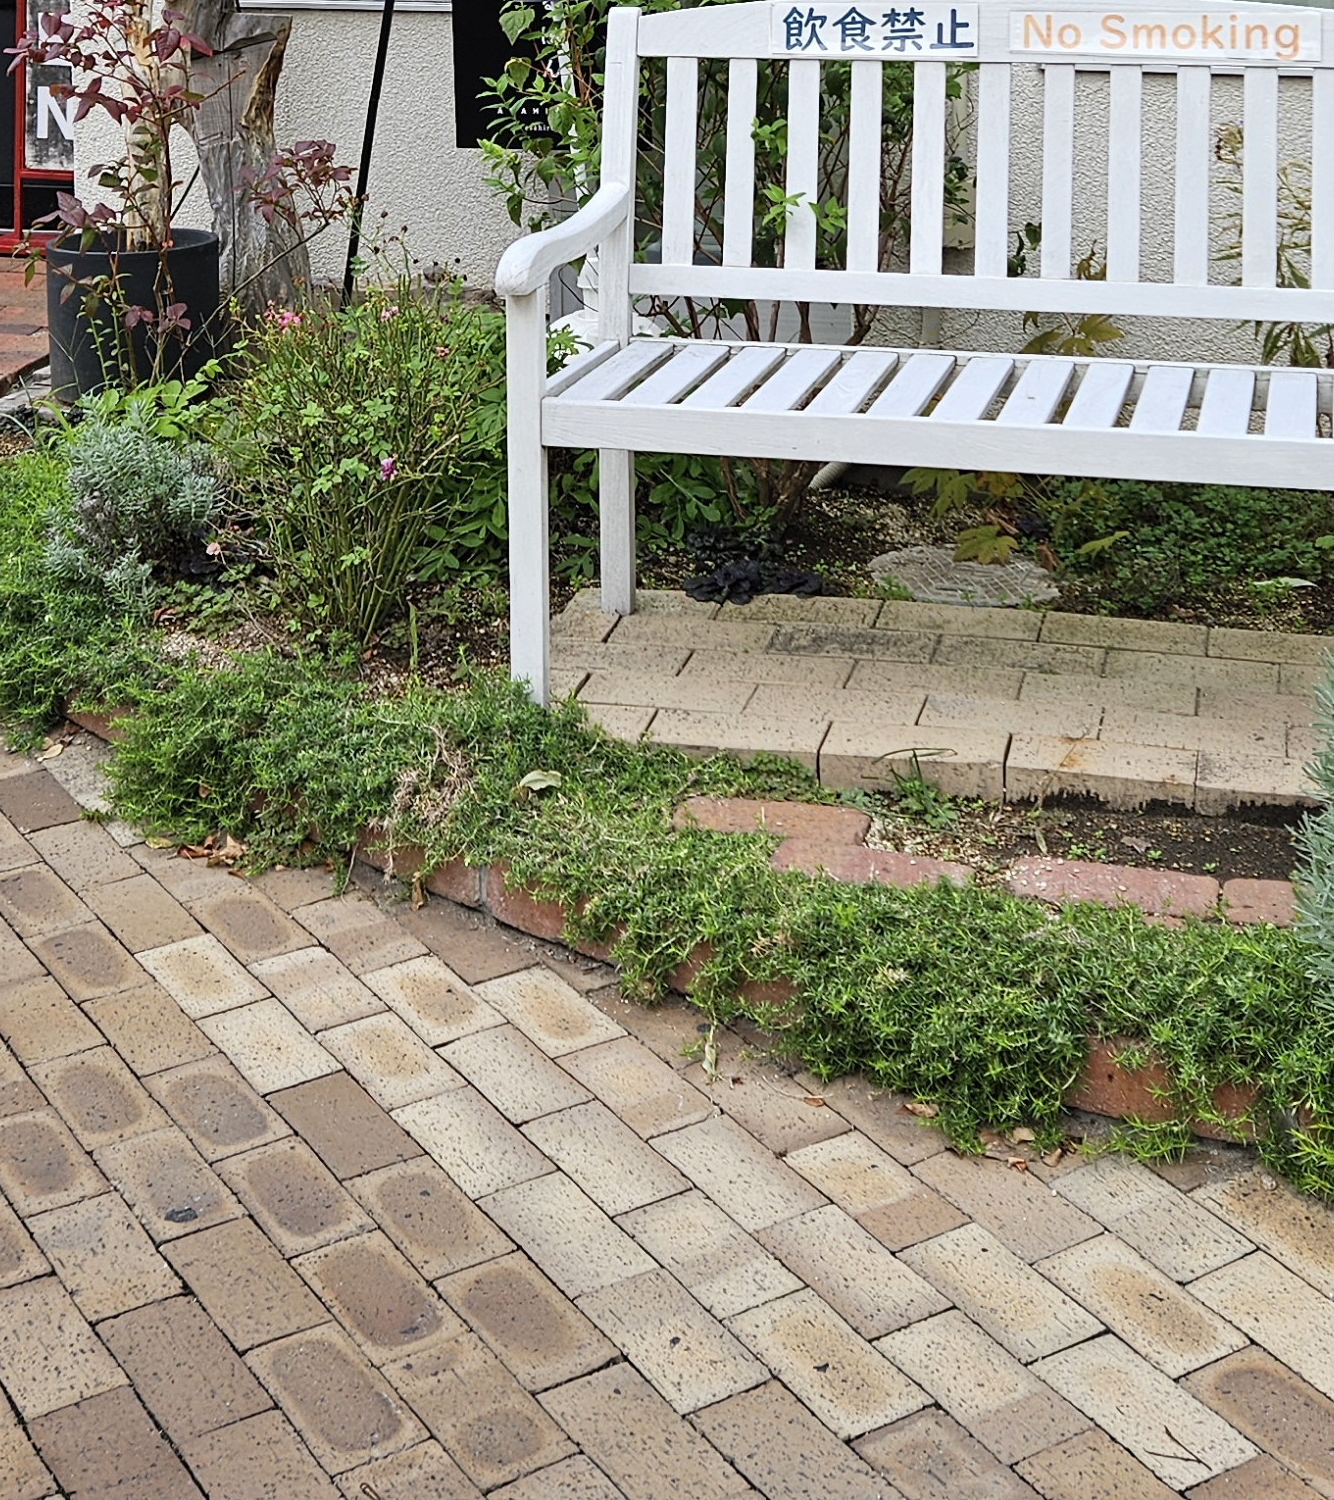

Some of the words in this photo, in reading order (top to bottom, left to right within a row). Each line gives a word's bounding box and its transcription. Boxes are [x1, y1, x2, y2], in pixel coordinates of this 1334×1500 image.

[782, 6, 975, 52] 飲食禁止
[1022, 14, 1082, 49] No
[1099, 13, 1301, 62] Smoking
